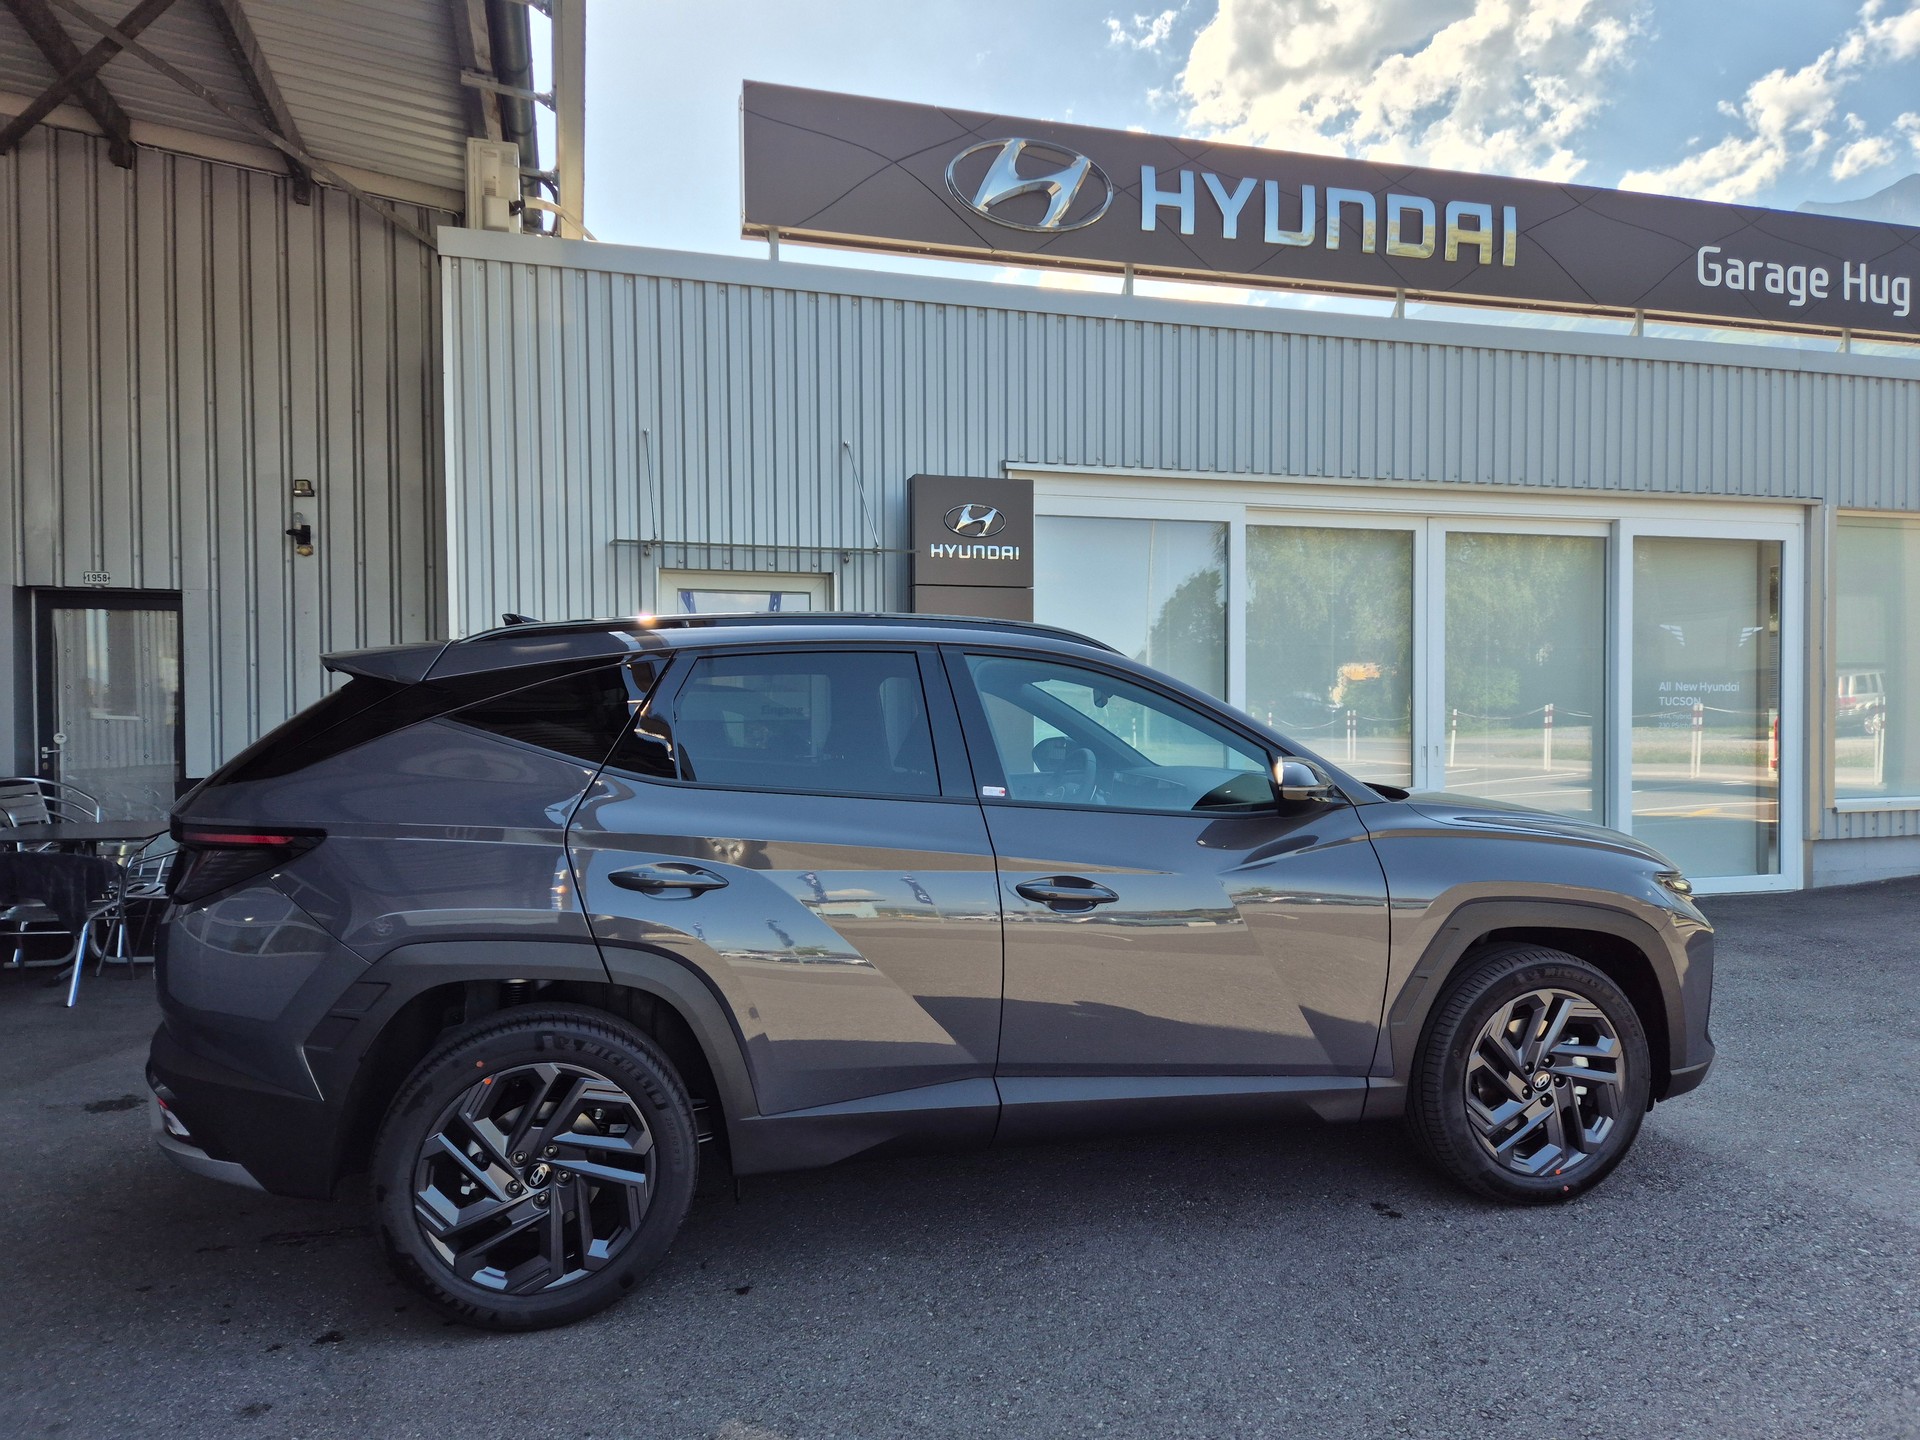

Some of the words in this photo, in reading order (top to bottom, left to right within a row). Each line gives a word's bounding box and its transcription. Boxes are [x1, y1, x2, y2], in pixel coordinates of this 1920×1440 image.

[1140, 165, 1517, 266] HYUNDAI
[1697, 246, 1829, 306] Garage
[1843, 261, 1910, 317] Hug
[930, 543, 1020, 560] HYUNDAI
[86, 573, 108, 582] 1958
[1658, 682, 1671, 692] All
[1675, 682, 1698, 692] New
[1699, 681, 1740, 694] Hyundai
[1658, 696, 1702, 706] TUCSON
